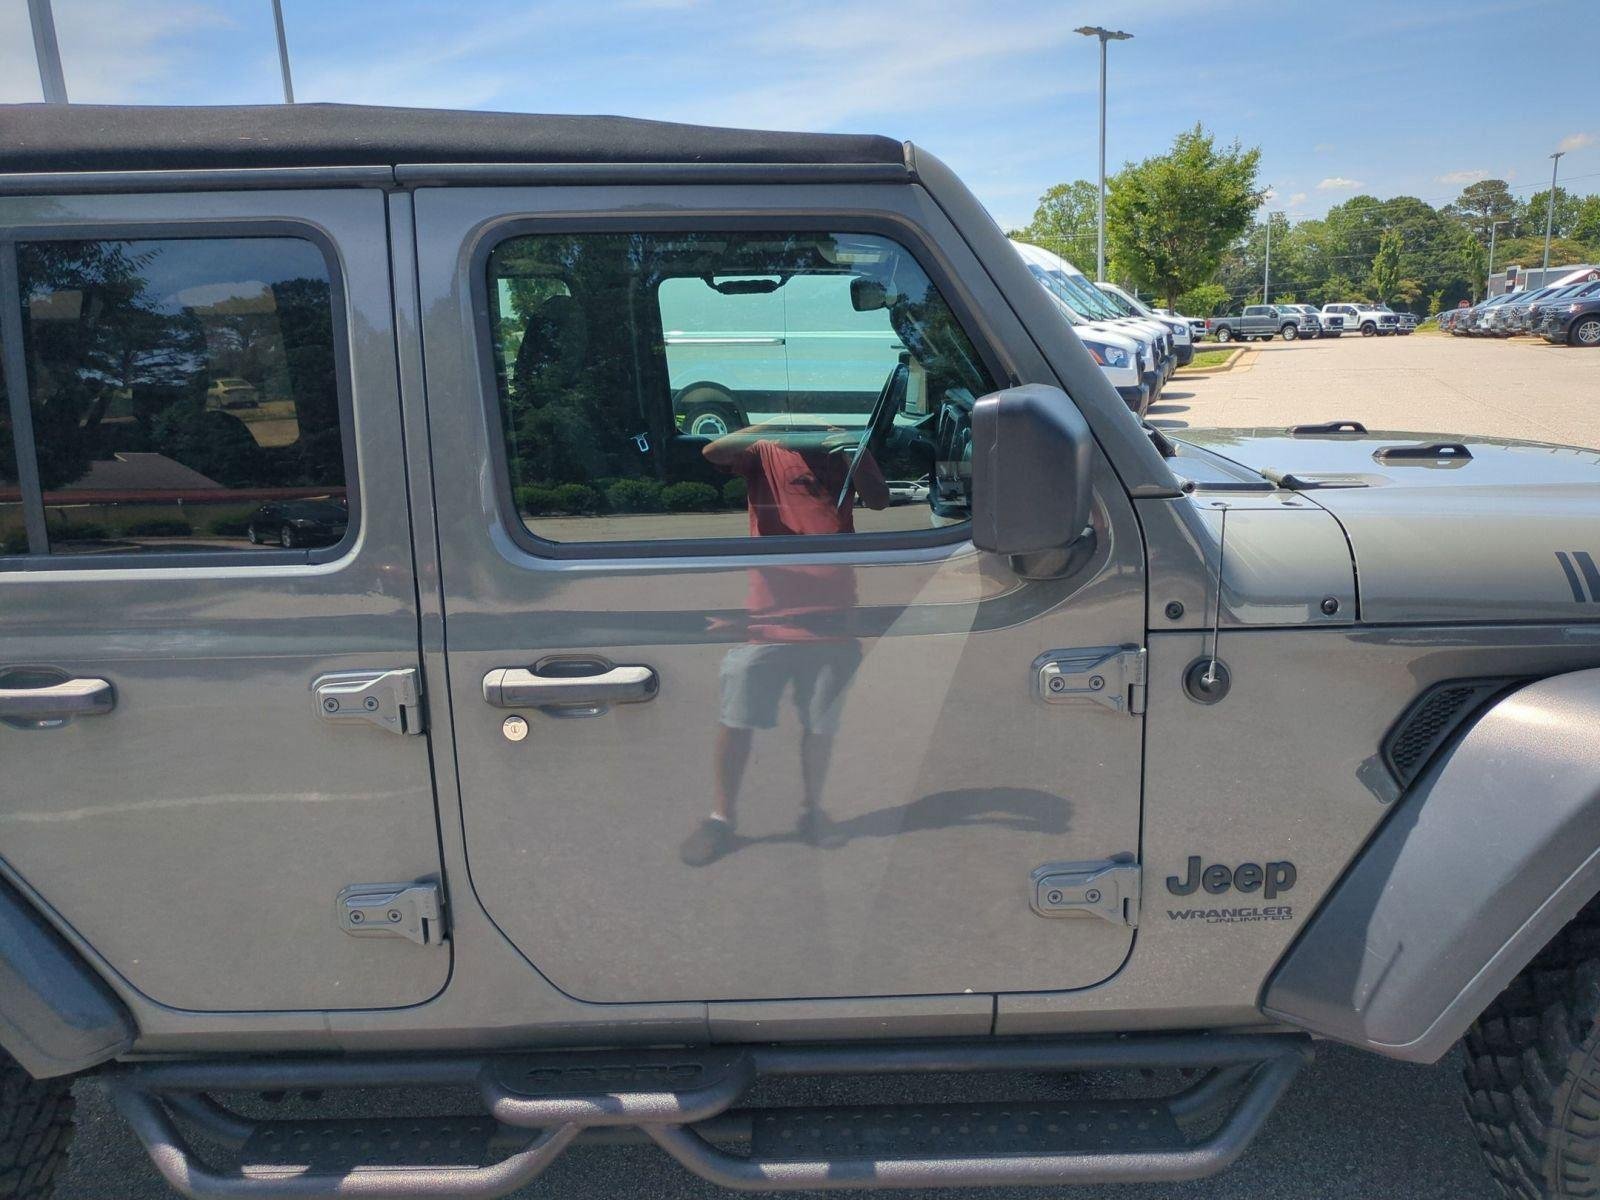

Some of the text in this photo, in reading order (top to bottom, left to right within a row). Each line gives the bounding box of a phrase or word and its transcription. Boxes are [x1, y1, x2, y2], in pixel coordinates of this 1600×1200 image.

[1166, 855, 1297, 899] Jeep
[1167, 906, 1293, 920] WRANGLER
[1206, 915, 1293, 924] UNLIMITED
